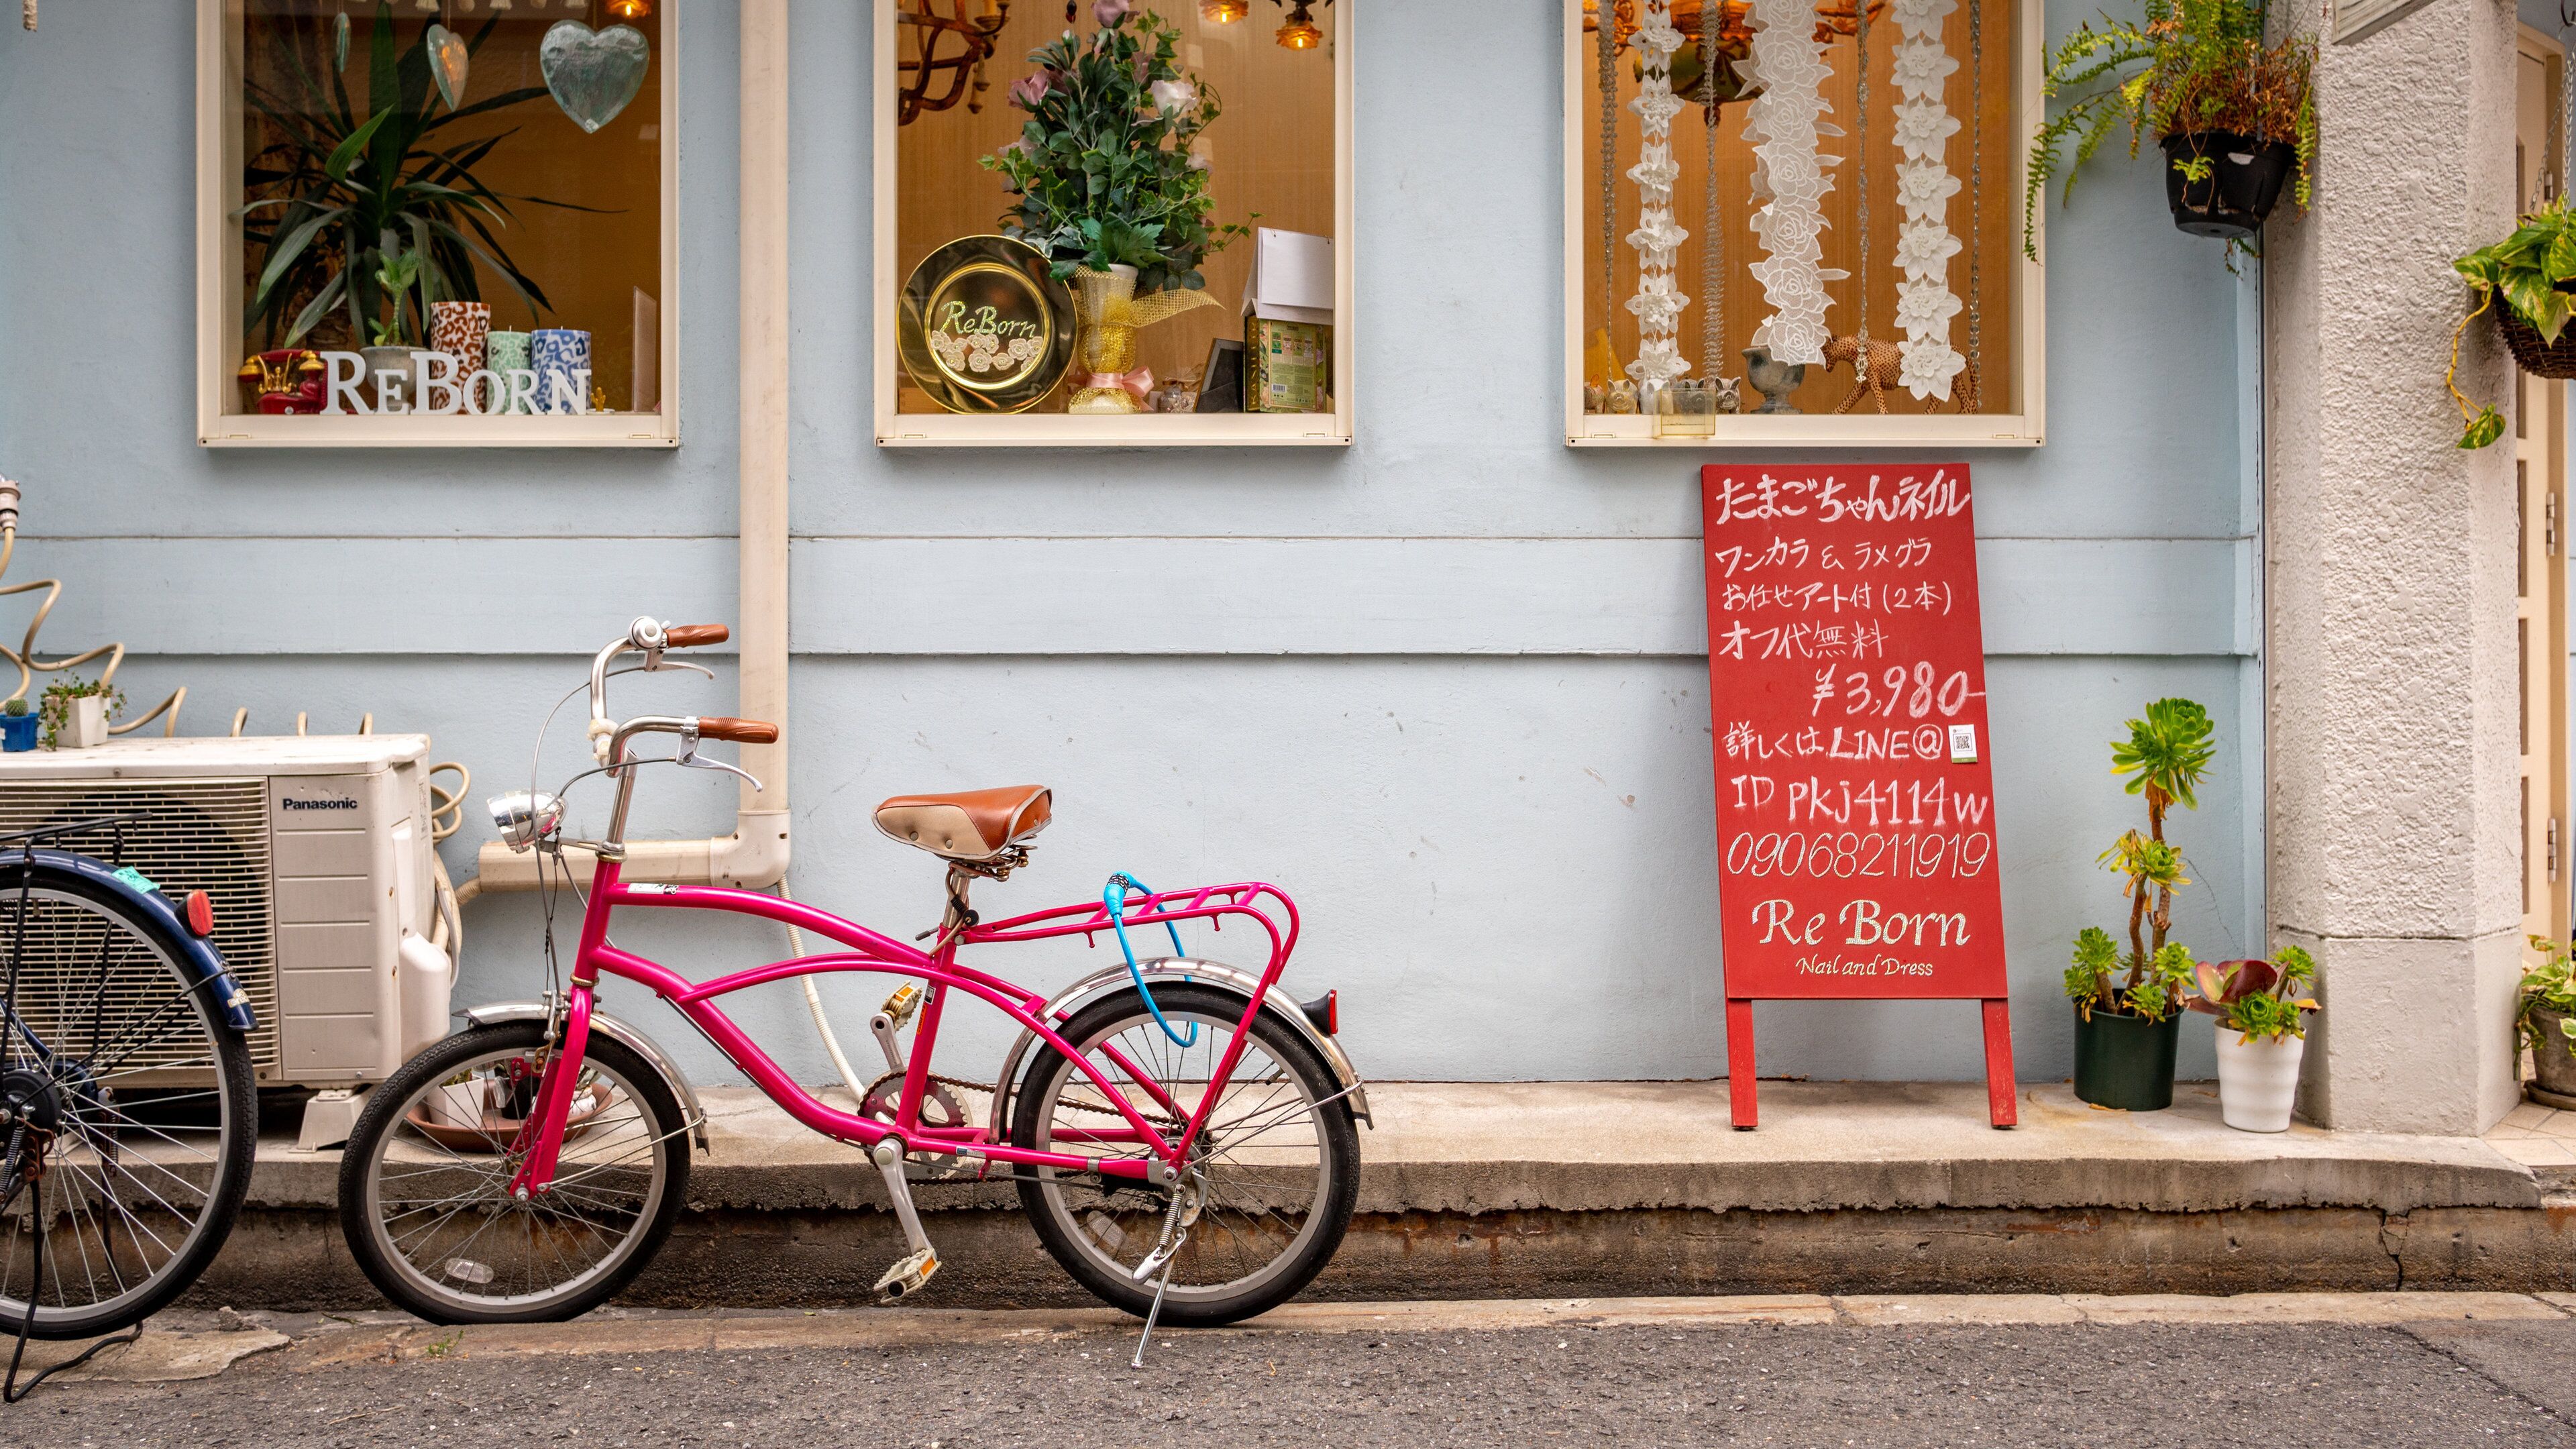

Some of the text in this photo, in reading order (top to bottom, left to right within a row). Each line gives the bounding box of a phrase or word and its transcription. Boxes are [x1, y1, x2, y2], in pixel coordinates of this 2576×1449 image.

[941, 301, 1036, 338] ReBorn
[1716, 469, 1971, 525] たまごちゃんネイル
[1715, 537, 1809, 578] ワンカラ
[1854, 537, 1931, 570] ラメグラ
[1719, 619, 1888, 660] オフ代無料
[282, 797, 358, 810] Panasonic
[1731, 775, 1774, 808] ID
[1727, 832, 1990, 879] 09068211919
[1752, 899, 1971, 947] Re Born
[1795, 953, 1933, 976] Nail and Dress
